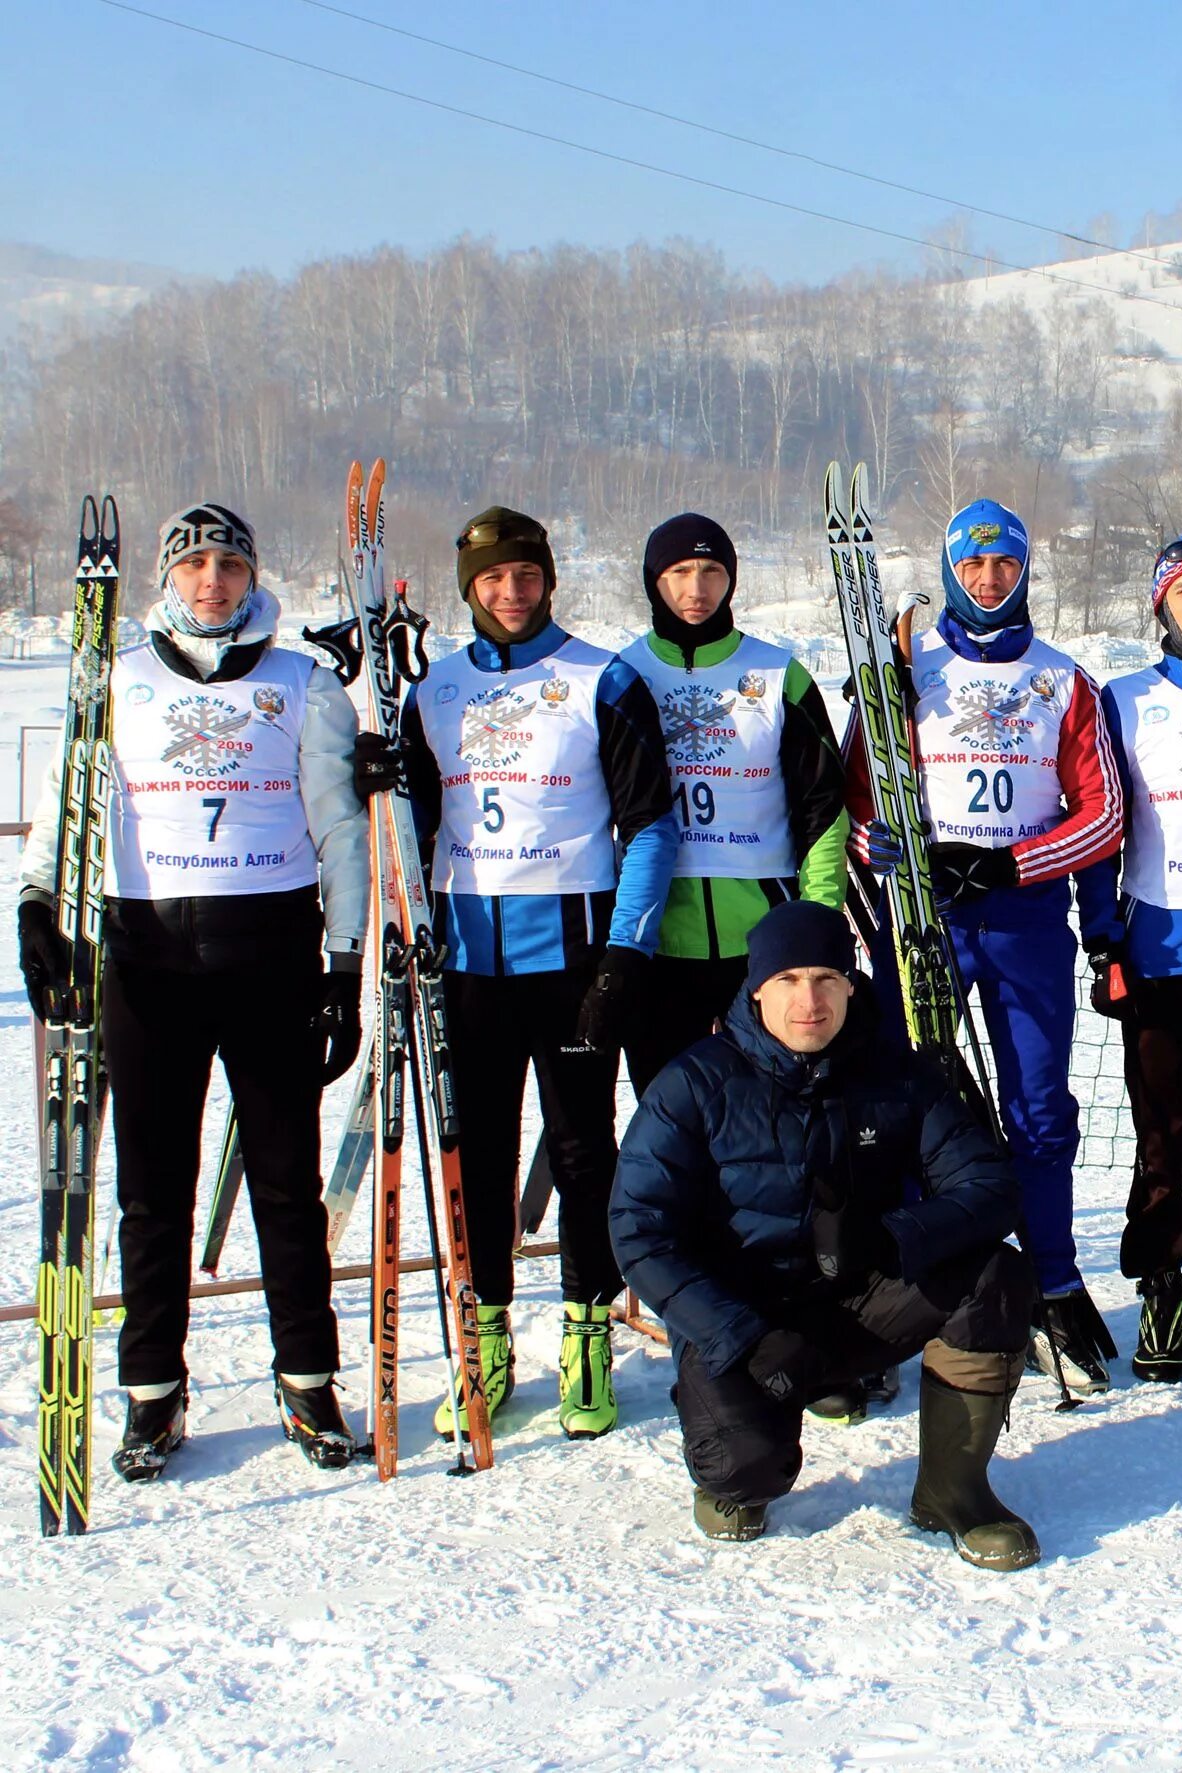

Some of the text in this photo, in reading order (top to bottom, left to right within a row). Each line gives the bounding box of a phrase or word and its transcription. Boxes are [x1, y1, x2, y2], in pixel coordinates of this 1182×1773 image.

[842, 551, 867, 638] FISCHER
[866, 550, 888, 637] FISCHER
[72, 584, 87, 650] FISCHER
[91, 583, 106, 650] FISCHER
[664, 685, 723, 703] ЛЫЖНЯ
[959, 679, 1019, 696] ЛЫЖНЯ
[168, 695, 237, 714] ЛЫЖНЯ
[1002, 718, 1034, 728] 2019
[502, 731, 533, 742] 2019
[705, 727, 736, 738] 2019
[217, 740, 254, 752] 2019
[961, 735, 1025, 751] РОССИИ
[464, 751, 521, 768] РОССИИ
[666, 747, 726, 762] РОССИИ
[919, 753, 967, 765] ЫЖНЯ
[971, 753, 1029, 765] РОССИИ
[173, 760, 241, 777] РОССИИ
[676, 765, 731, 777] РОССИИ
[744, 767, 770, 778] 2019
[186, 780, 250, 792] РОССИИ
[264, 781, 291, 791] 2019
[473, 771, 527, 783] РОССИИ
[541, 775, 572, 786] 2019
[966, 769, 1014, 813] 20
[483, 787, 505, 833] 5
[673, 781, 715, 827] 19
[203, 798, 226, 842] 7
[679, 830, 761, 844] ублика Алтай
[938, 820, 1014, 838] Республика
[146, 851, 286, 869] Республика Алтай
[519, 846, 560, 860] Алтай
[375, 991, 383, 1085] ROSSIGNOL
